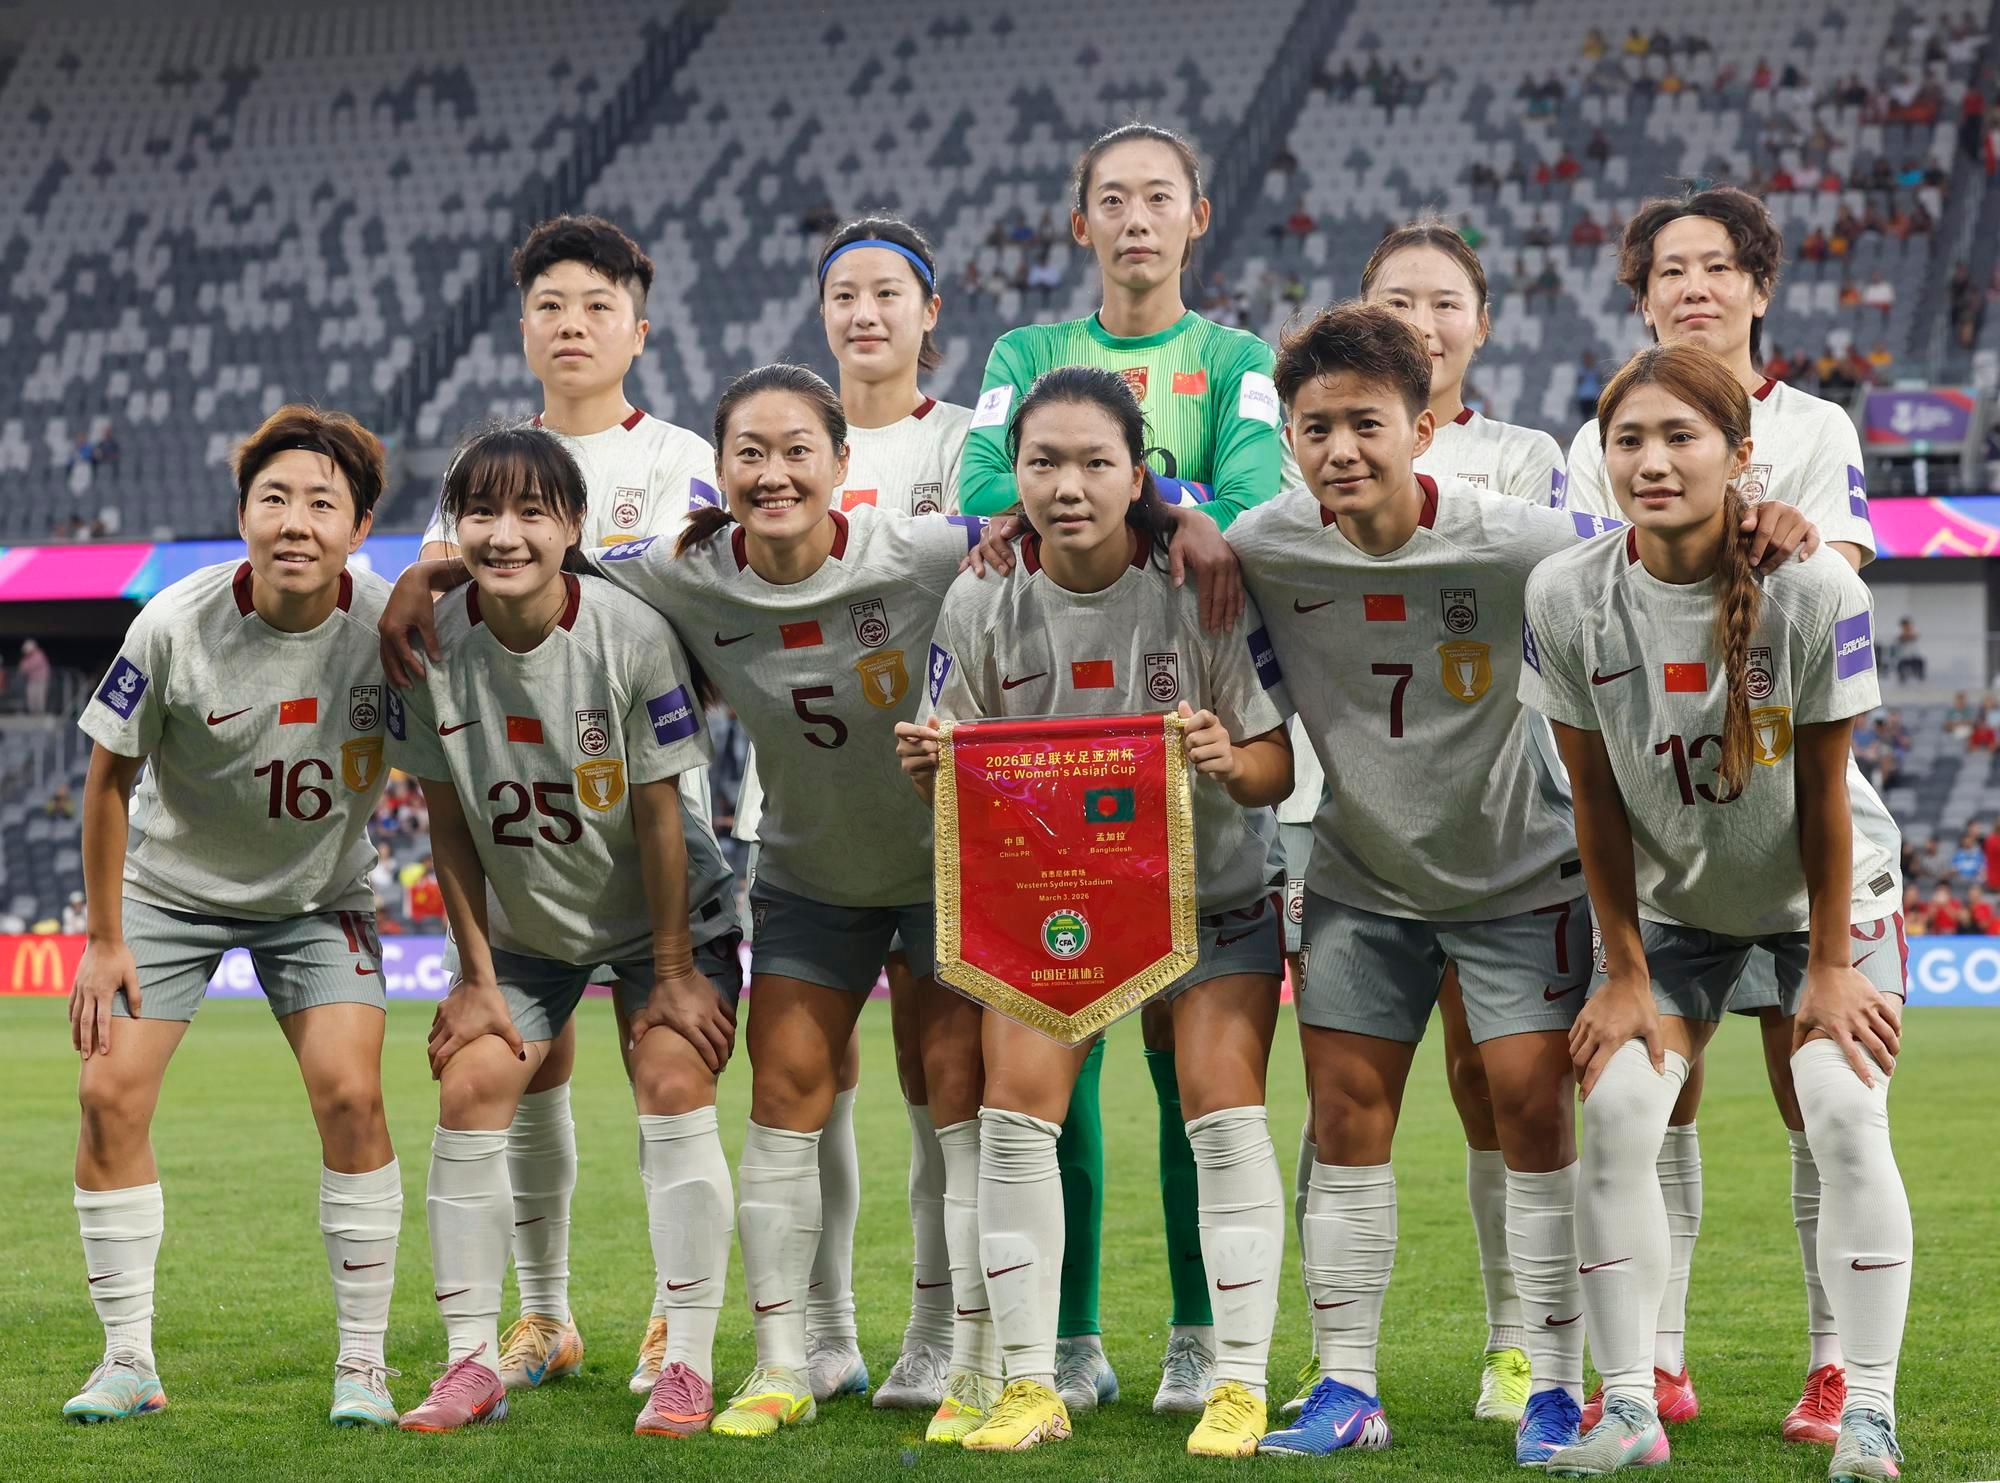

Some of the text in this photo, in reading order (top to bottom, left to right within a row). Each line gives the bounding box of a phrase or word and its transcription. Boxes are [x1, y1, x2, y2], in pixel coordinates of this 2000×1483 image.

[618, 489, 642, 499] CFA
[914, 485, 940, 494] CFA
[1444, 591, 1472, 599] CFA
[853, 602, 881, 615] CFA
[1148, 656, 1175, 665] CFA
[1746, 651, 1769, 660] FA
[353, 688, 378, 698] CFA
[1372, 664, 1413, 738] 7
[579, 713, 606, 721] CFA
[791, 685, 848, 749] 5
[986, 748, 1135, 768] 2026亚足联女足亚洲杯
[985, 764, 1136, 781] AFC Women's Asian Cup
[1655, 734, 1743, 806] 13
[253, 758, 333, 822] 16
[487, 780, 583, 848] 25
[1004, 836, 1025, 847] 中国
[1096, 832, 1126, 842] 孟加拉
[1090, 846, 1133, 854] Bangladesh
[1016, 878, 1113, 889] Western Sydney Stadium
[1072, 892, 1089, 900] 2026
[1059, 939, 1073, 947] CFA
[1533, 902, 1571, 974] 7
[1031, 967, 1105, 982] 中国足球协会
[1905, 948, 2000, 994] GO
